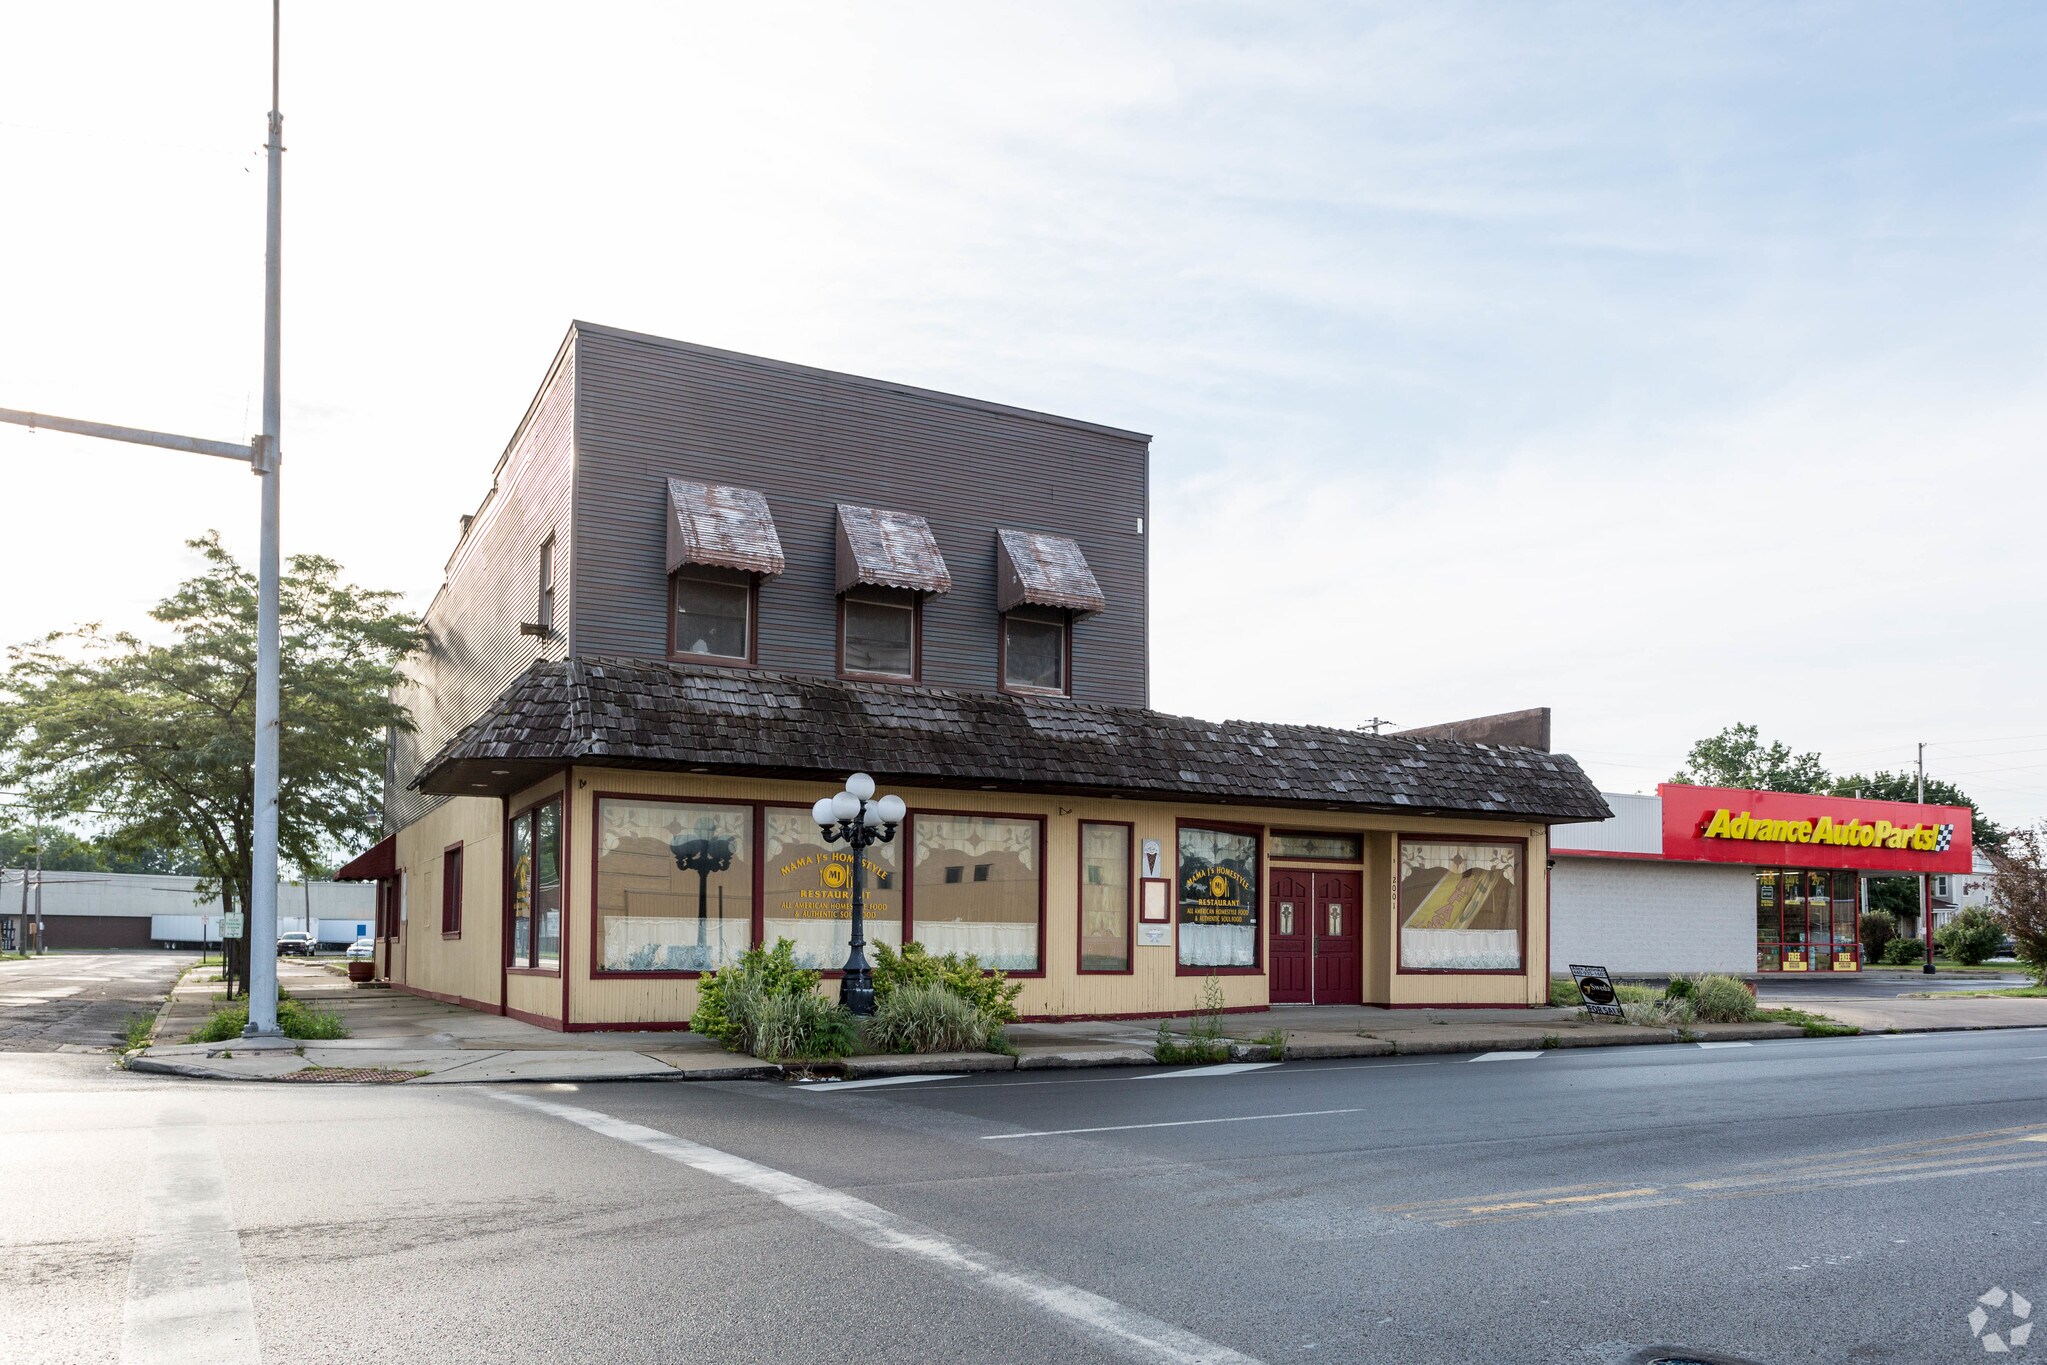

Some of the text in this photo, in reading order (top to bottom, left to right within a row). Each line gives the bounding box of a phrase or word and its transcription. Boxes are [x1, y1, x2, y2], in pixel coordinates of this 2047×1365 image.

[1704, 808, 1936, 851] Advance Auto Parts
[781, 856, 813, 877] MAMA
[832, 852, 888, 880] HOMSTYLE
[828, 870, 841, 882] MJ
[1187, 869, 1206, 886] MAMA
[1217, 867, 1249, 890] HOMESTYLE
[800, 890, 871, 899] RESTAURT
[794, 902, 828, 910] AMERICAN
[830, 902, 867, 910] HOMESE
[869, 903, 888, 911] FOOD
[794, 910, 799, 918] &
[802, 910, 838, 918] AUTHENTIC
[1788, 952, 1801, 962] FREE
[1838, 952, 1851, 962] FREE
[1587, 1005, 1602, 1013] FOR
